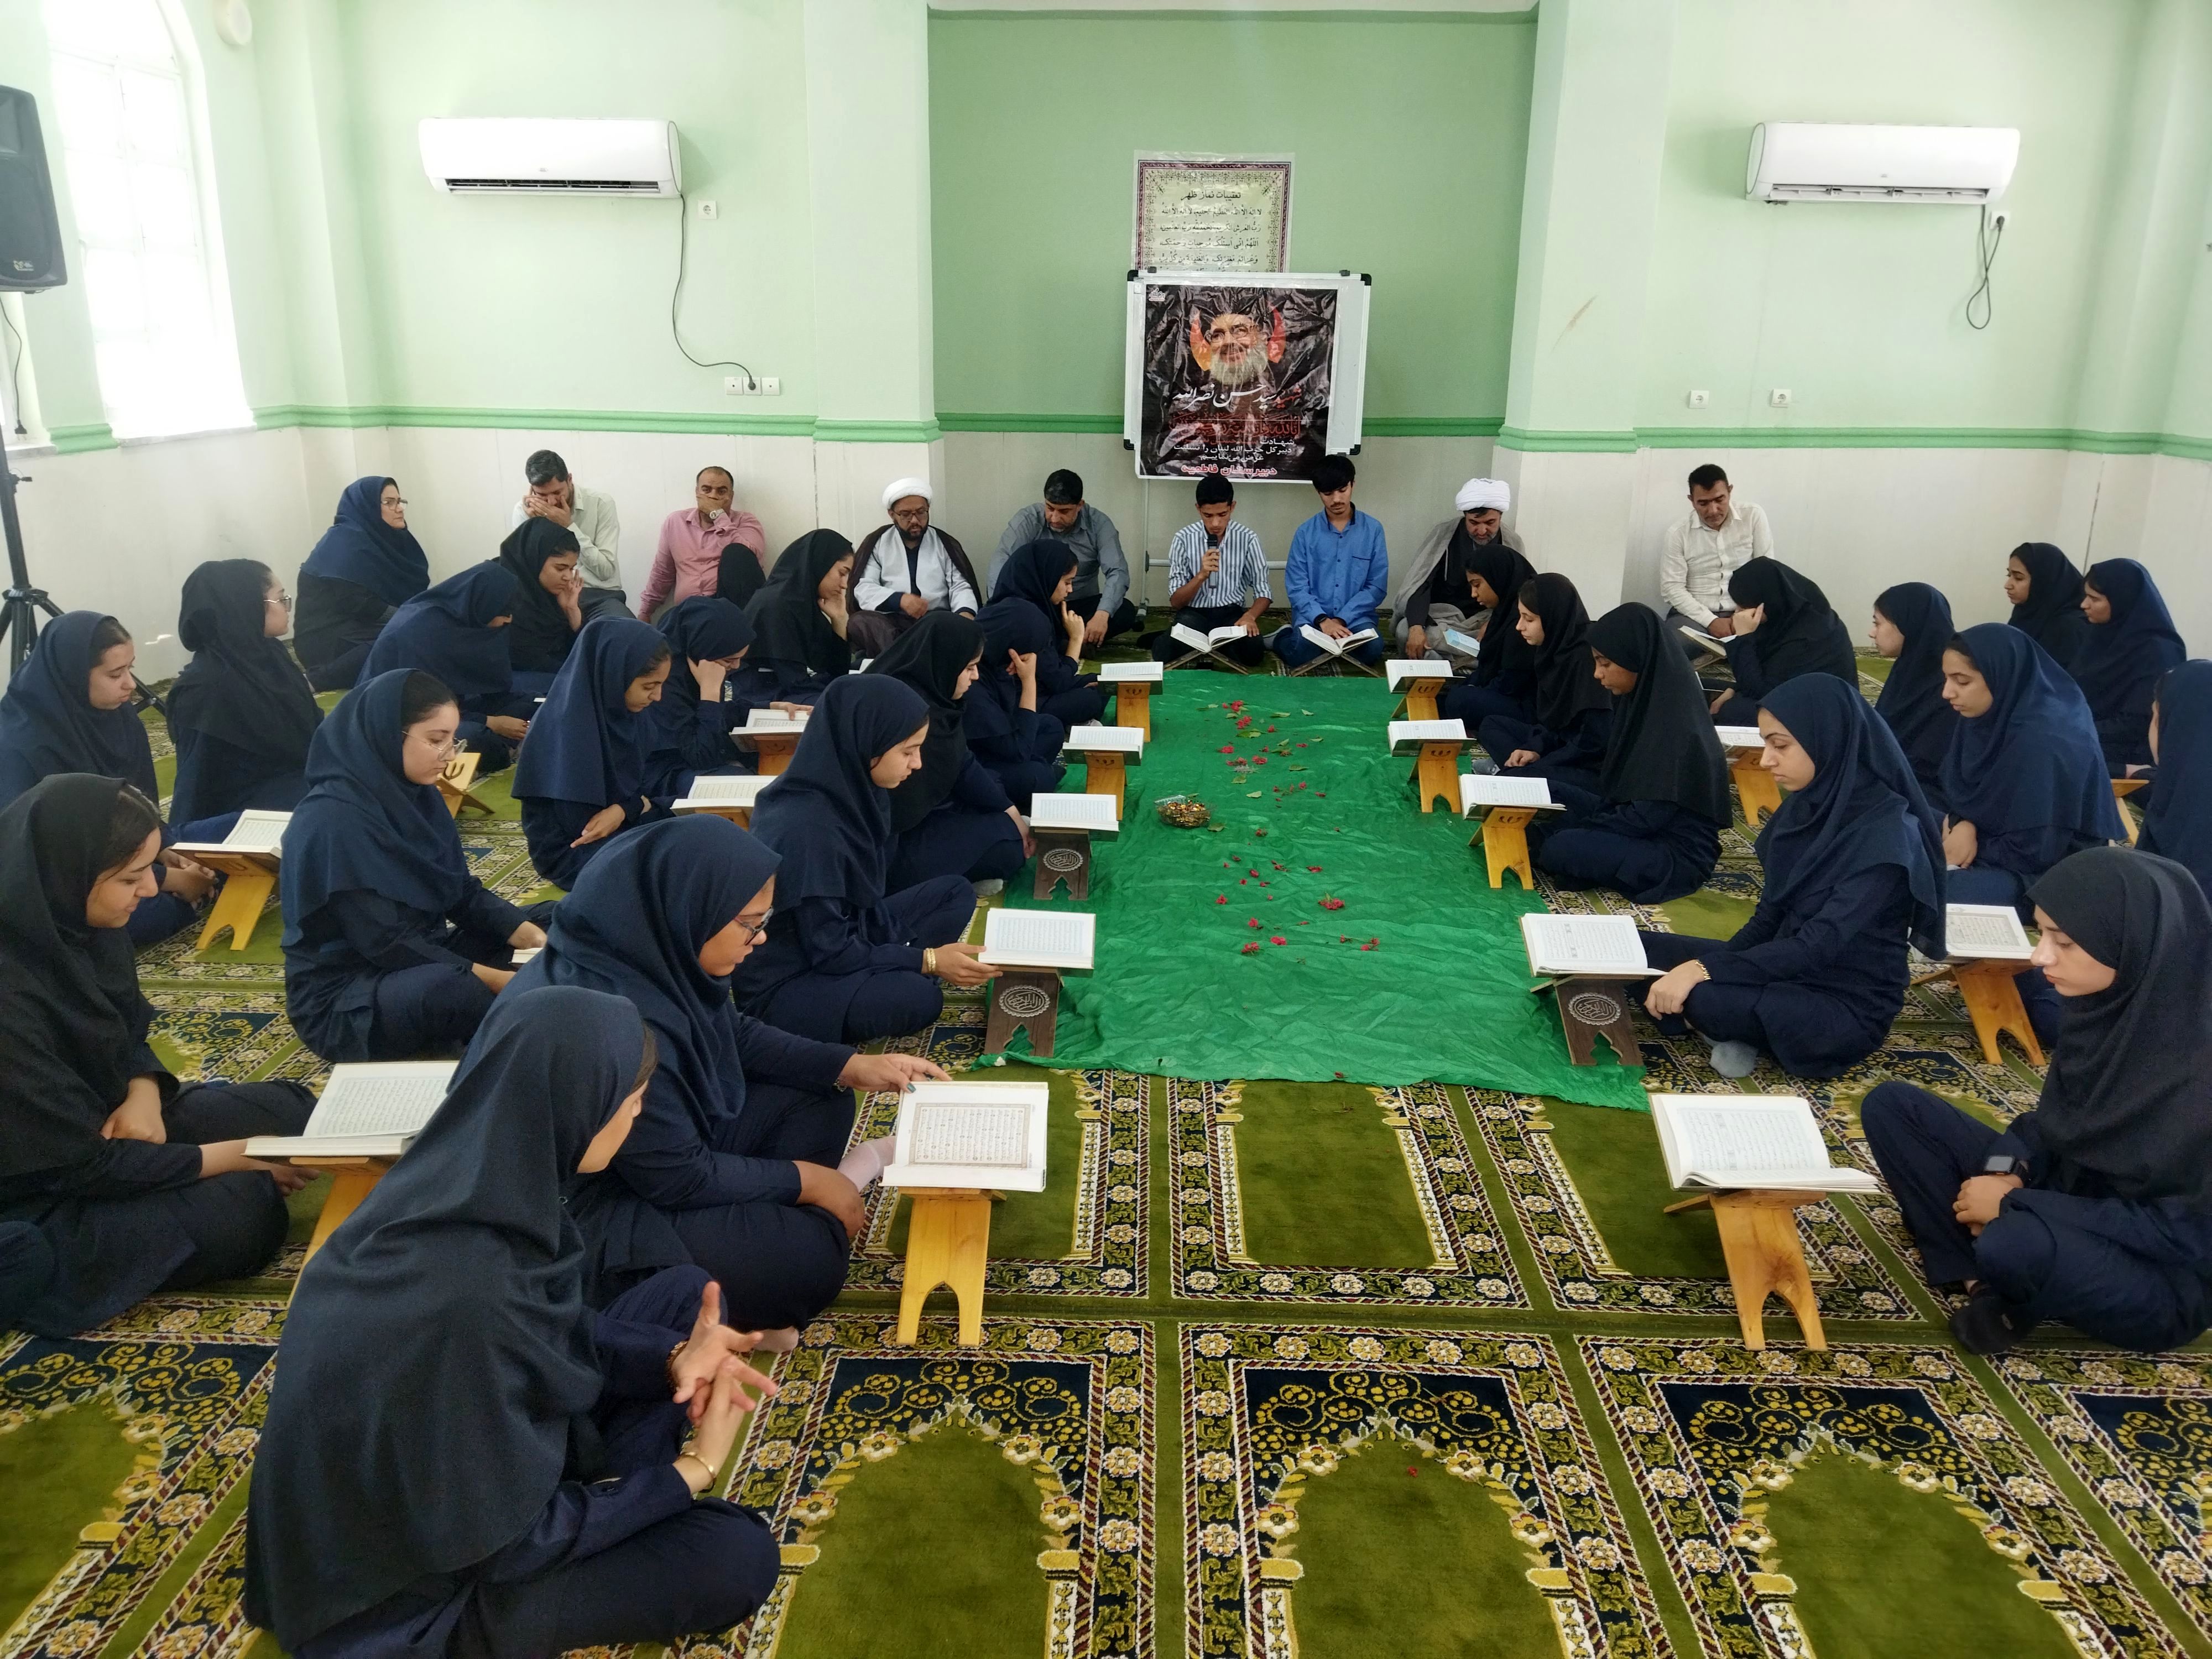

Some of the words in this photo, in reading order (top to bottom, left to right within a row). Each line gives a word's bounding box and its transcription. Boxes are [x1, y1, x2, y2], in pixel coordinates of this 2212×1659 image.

[1181, 190, 1197, 201] ظهر
[1199, 190, 1214, 200] نماز
[1217, 190, 1241, 201] تعقیبات
[1213, 384, 1267, 408] حسن
[1252, 394, 1277, 409] سید
[1260, 437, 1295, 447] شهادت
[1202, 444, 1209, 453] را
[1211, 445, 1229, 453] لبنان
[1181, 463, 1218, 475] فاطمیه
[1220, 465, 1277, 476] دبیرستان
